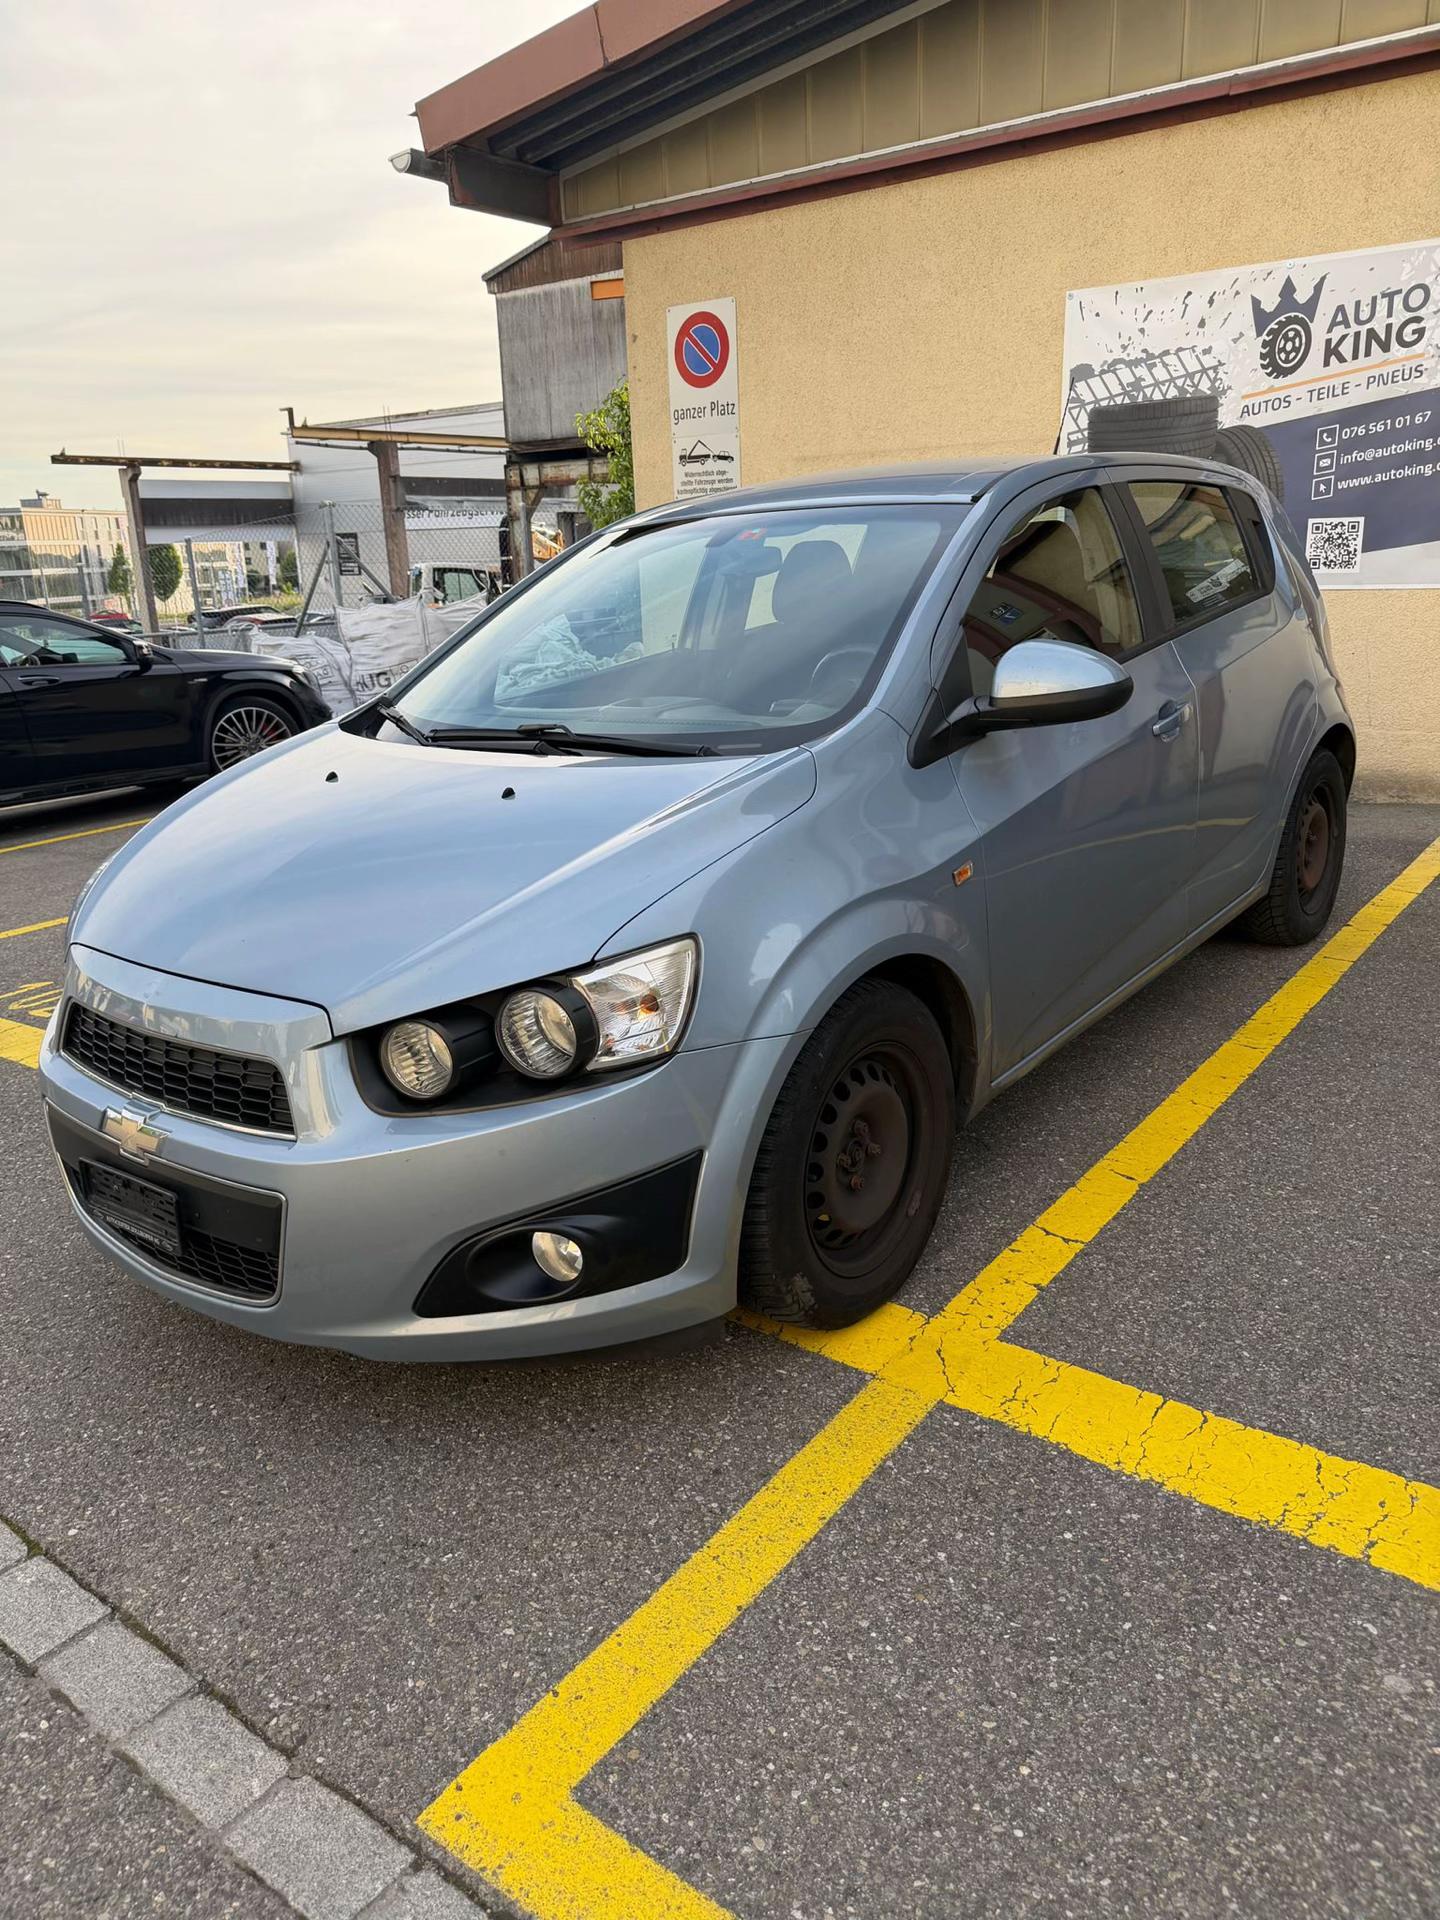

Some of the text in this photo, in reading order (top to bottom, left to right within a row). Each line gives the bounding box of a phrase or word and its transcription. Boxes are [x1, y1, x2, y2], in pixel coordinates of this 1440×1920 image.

[1326, 283, 1431, 334] AUTO
[1323, 315, 1427, 368] KING
[673, 399, 736, 426] ganzer Platz
[1240, 395, 1292, 419] AUTOS
[1307, 381, 1350, 403] TEILE
[1366, 364, 1424, 390] PNEUS
[1341, 410, 1432, 440] 076 561 01 67
